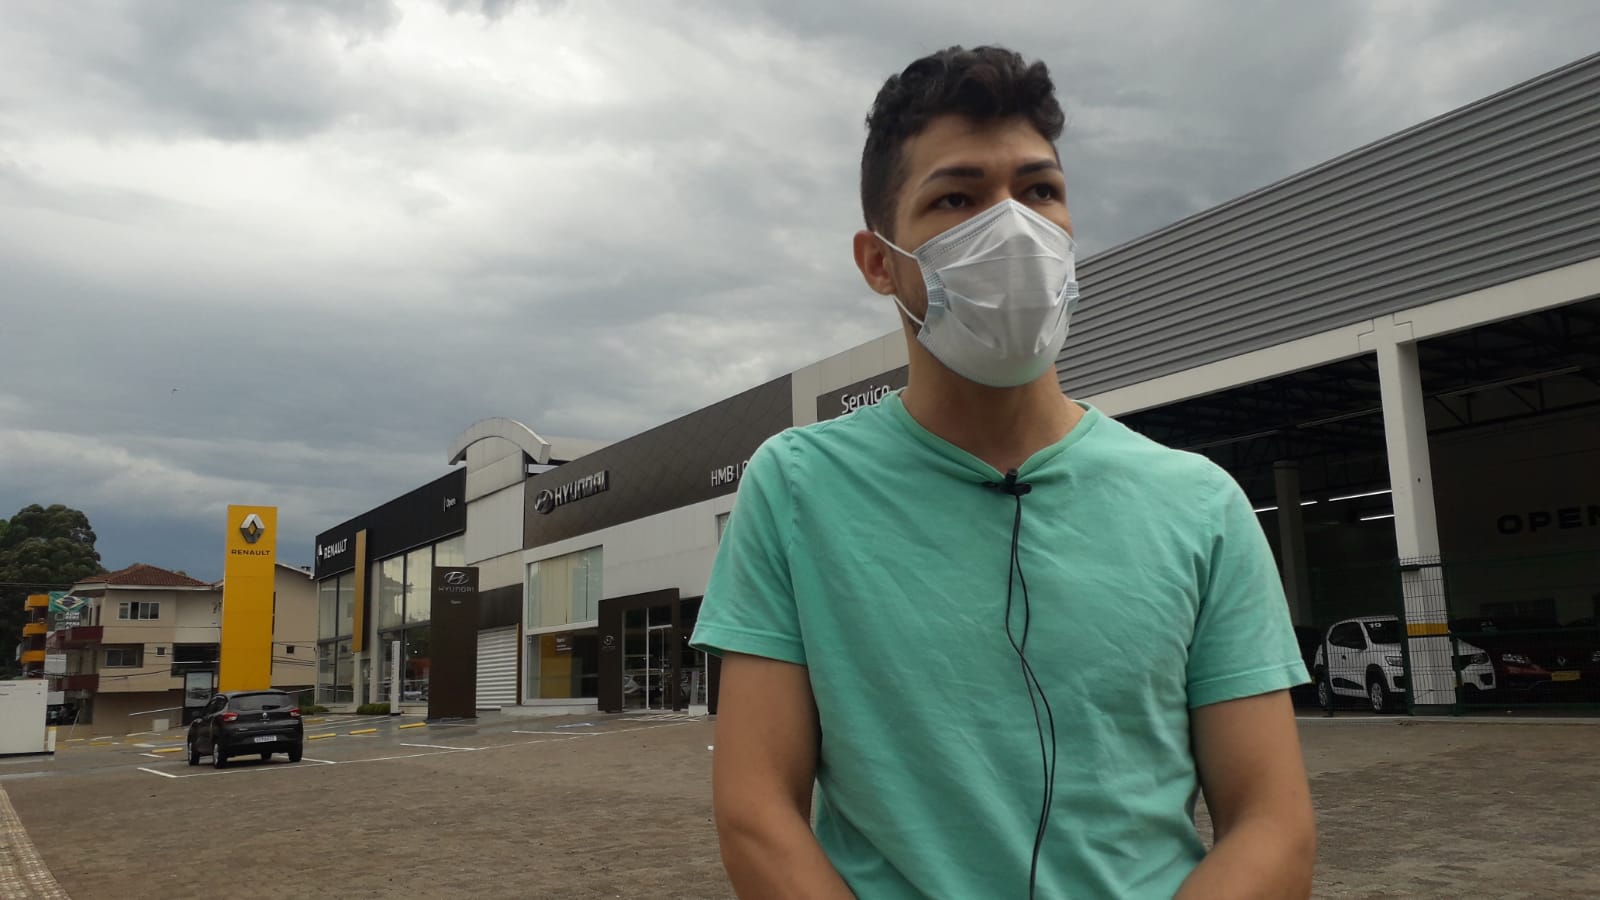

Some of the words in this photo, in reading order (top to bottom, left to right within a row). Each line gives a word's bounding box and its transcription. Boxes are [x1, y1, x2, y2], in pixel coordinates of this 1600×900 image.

[711, 465, 735, 487] HMB
[554, 470, 608, 508] HYUNDAI
[231, 548, 270, 556] RENAULT
[323, 538, 348, 561] RENAULT
